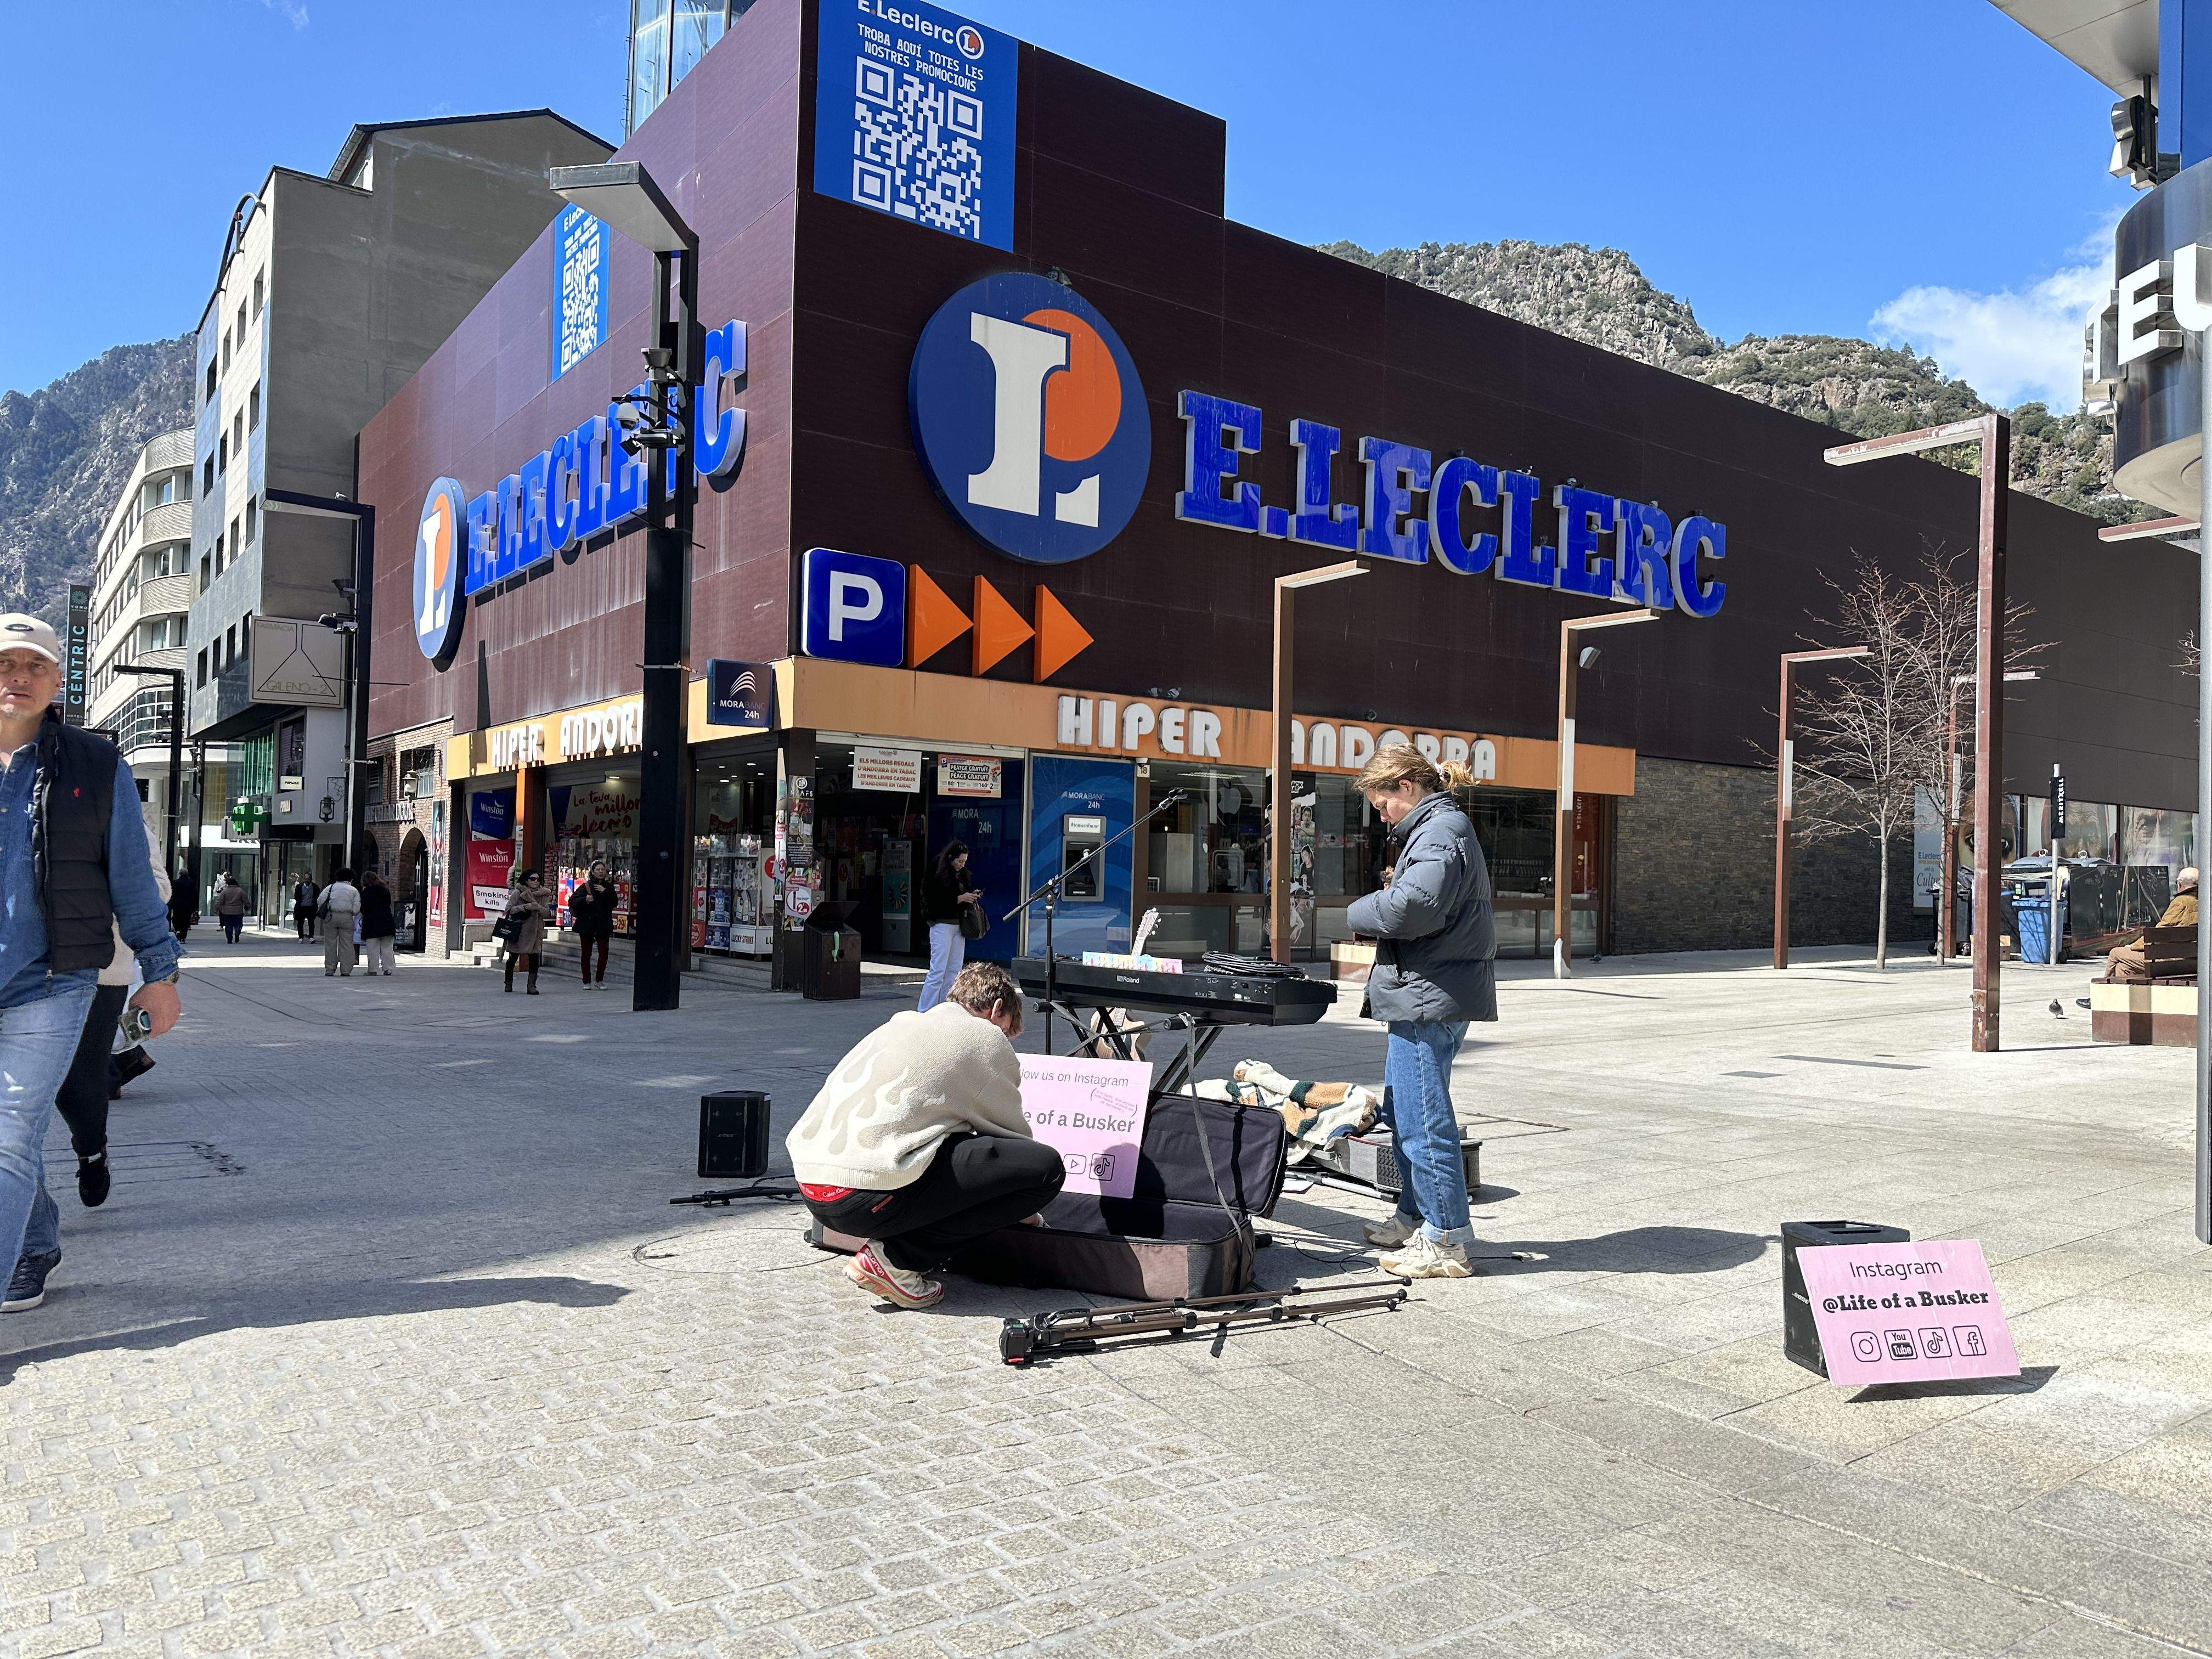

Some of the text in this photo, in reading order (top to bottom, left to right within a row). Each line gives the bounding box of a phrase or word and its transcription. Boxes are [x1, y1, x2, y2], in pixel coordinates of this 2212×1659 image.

[857, 0, 953, 44] E.Leclerc
[857, 23, 983, 81] TROBA AQUÍ TOTES LES
[865, 41, 976, 92] NOSTRES PROMOCIONS
[829, 571, 883, 641] P
[257, 622, 295, 631] FARMACIA
[744, 710, 760, 719] 24h
[1058, 694, 1221, 758] HIPER
[492, 723, 544, 767] HIPER
[481, 802, 504, 815] Winston
[1088, 801, 1101, 809] 24h
[978, 821, 992, 833] 24h
[479, 851, 509, 862] Winston
[475, 890, 510, 901] Smoking
[485, 898, 500, 906] kills
[1123, 975, 1140, 984] Roland
[1042, 1072, 1054, 1081] us
[1057, 1073, 1071, 1082] on
[1074, 1073, 1129, 1088] Instagram
[1036, 1110, 1055, 1125] of
[1057, 1114, 1068, 1127] a
[1073, 1113, 1135, 1133] Busker
[1849, 1261, 1943, 1280] Instagram
[1822, 1289, 1989, 1313] @Life of a Busker
[1891, 1332, 1906, 1341] You
[1892, 1345, 1912, 1355] Tube
